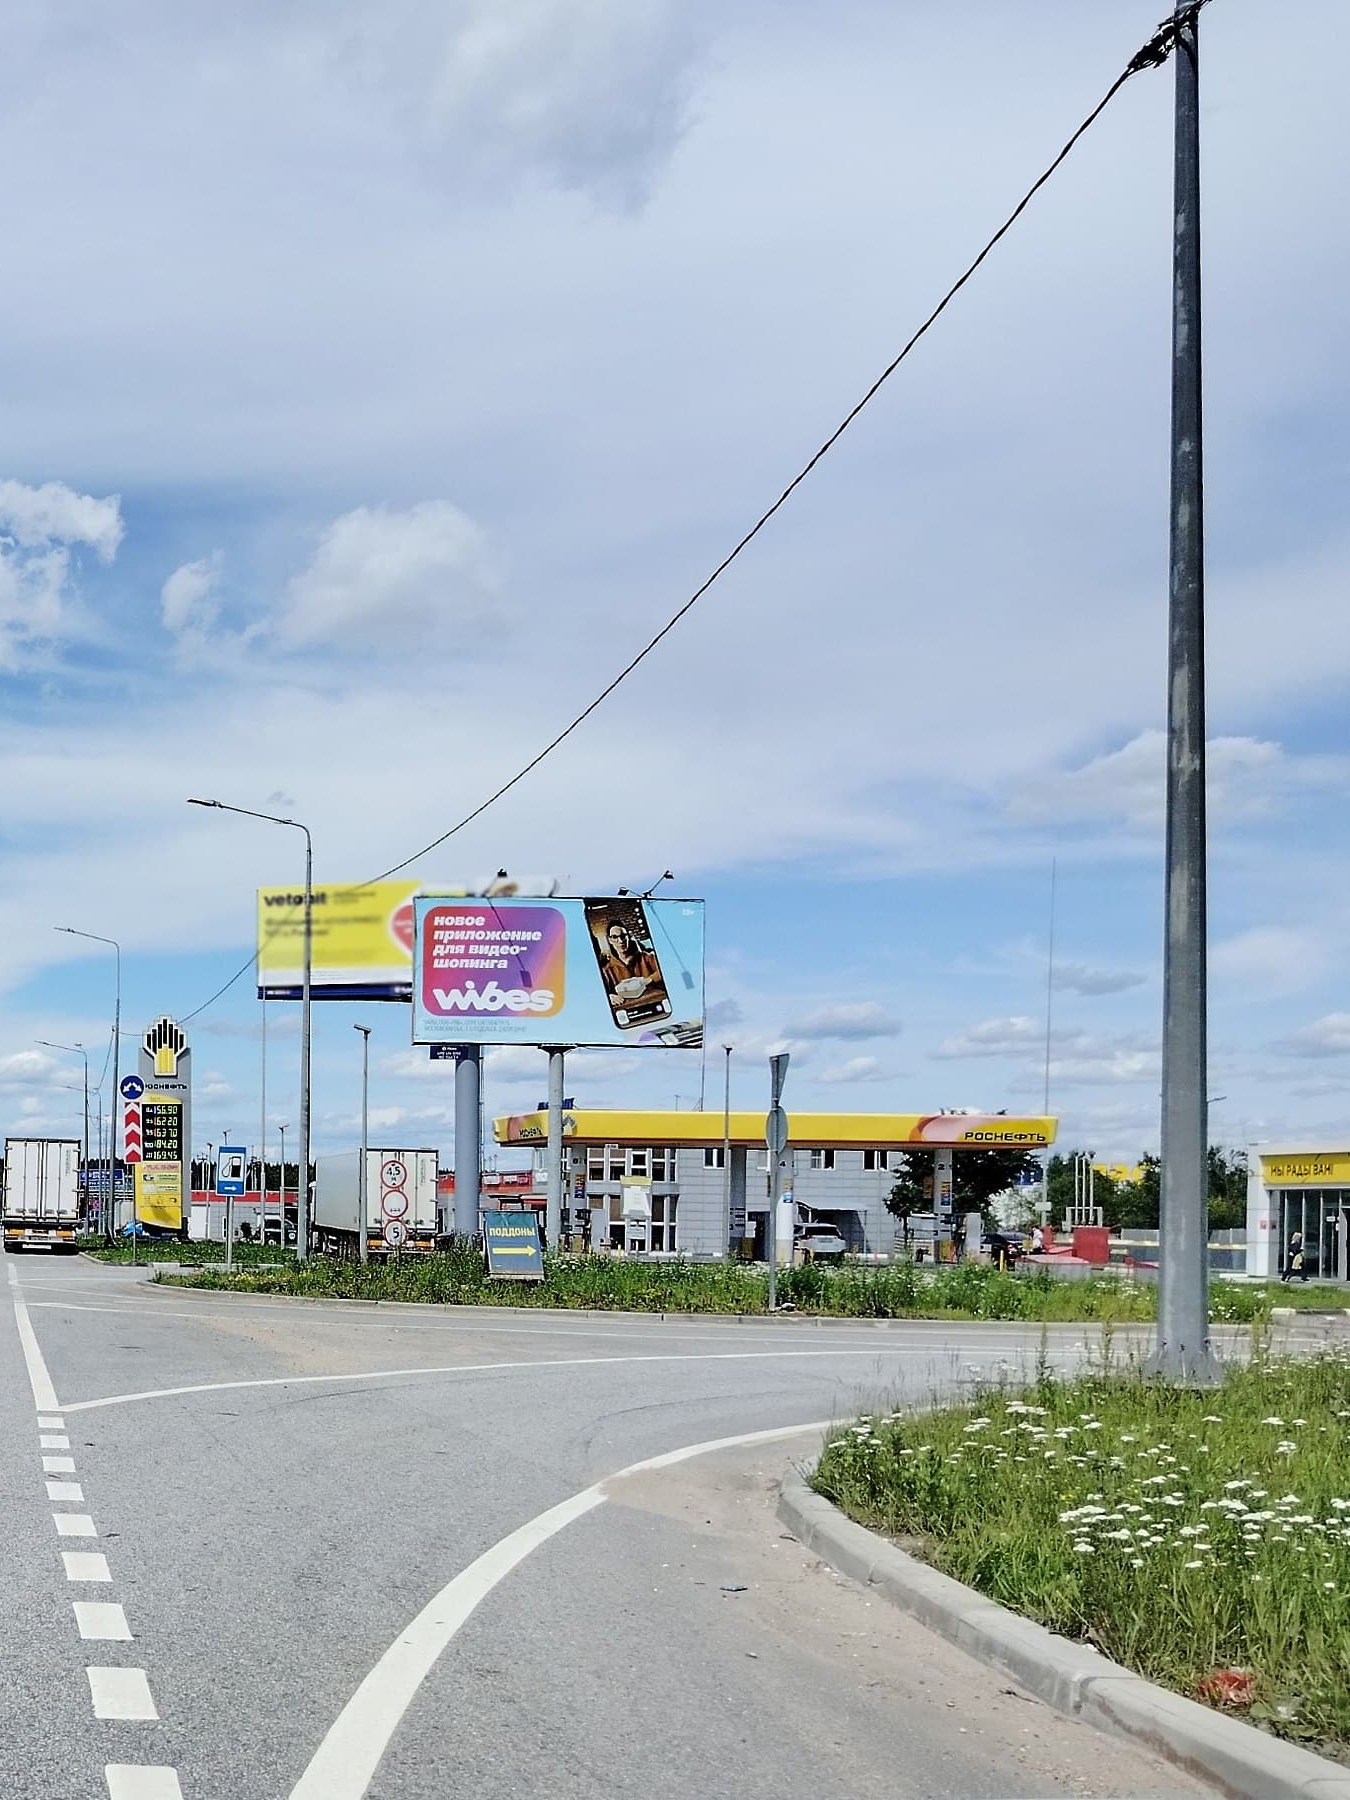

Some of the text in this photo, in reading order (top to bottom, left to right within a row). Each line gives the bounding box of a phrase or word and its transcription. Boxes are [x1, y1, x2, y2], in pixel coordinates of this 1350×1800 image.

[434, 916, 485, 926] новое
[433, 930, 542, 943] приложение
[433, 945, 527, 956] для видео-
[433, 959, 508, 968] шопинга
[156, 1116, 177, 1126] 6220
[156, 1128, 177, 1138] 6370
[964, 1131, 1046, 1141] РОСНЕФТЬ
[1286, 1164, 1311, 1177] РАДЫ
[392, 1227, 400, 1238] 5
[489, 1227, 536, 1237] ПОДДОНЫ
